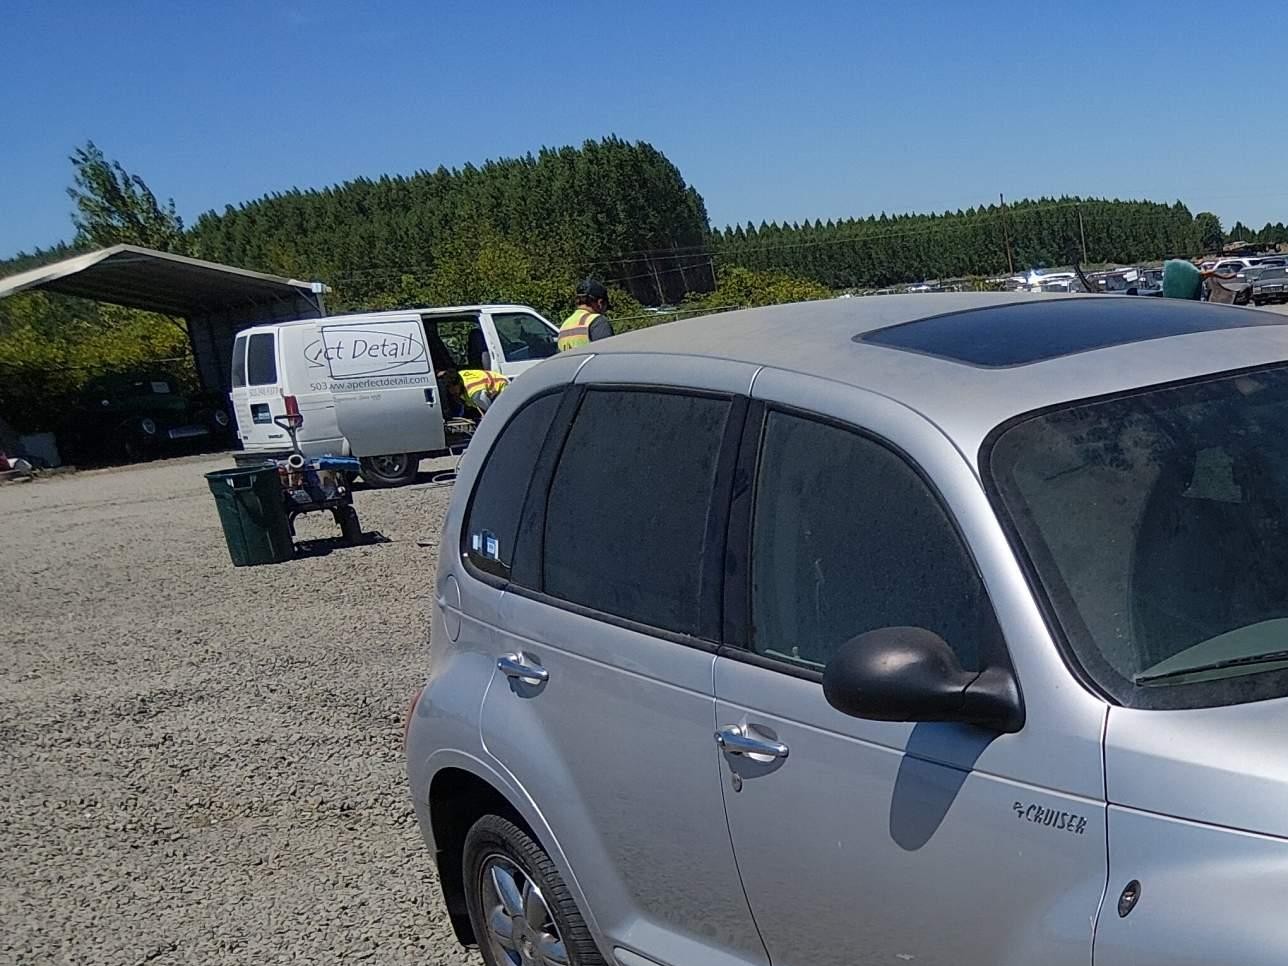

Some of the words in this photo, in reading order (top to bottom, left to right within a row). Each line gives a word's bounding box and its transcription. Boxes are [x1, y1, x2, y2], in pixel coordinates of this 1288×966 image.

[352, 333, 413, 360] Detail
[310, 381, 328, 392] 503
[1026, 803, 1087, 834] CRUISER
